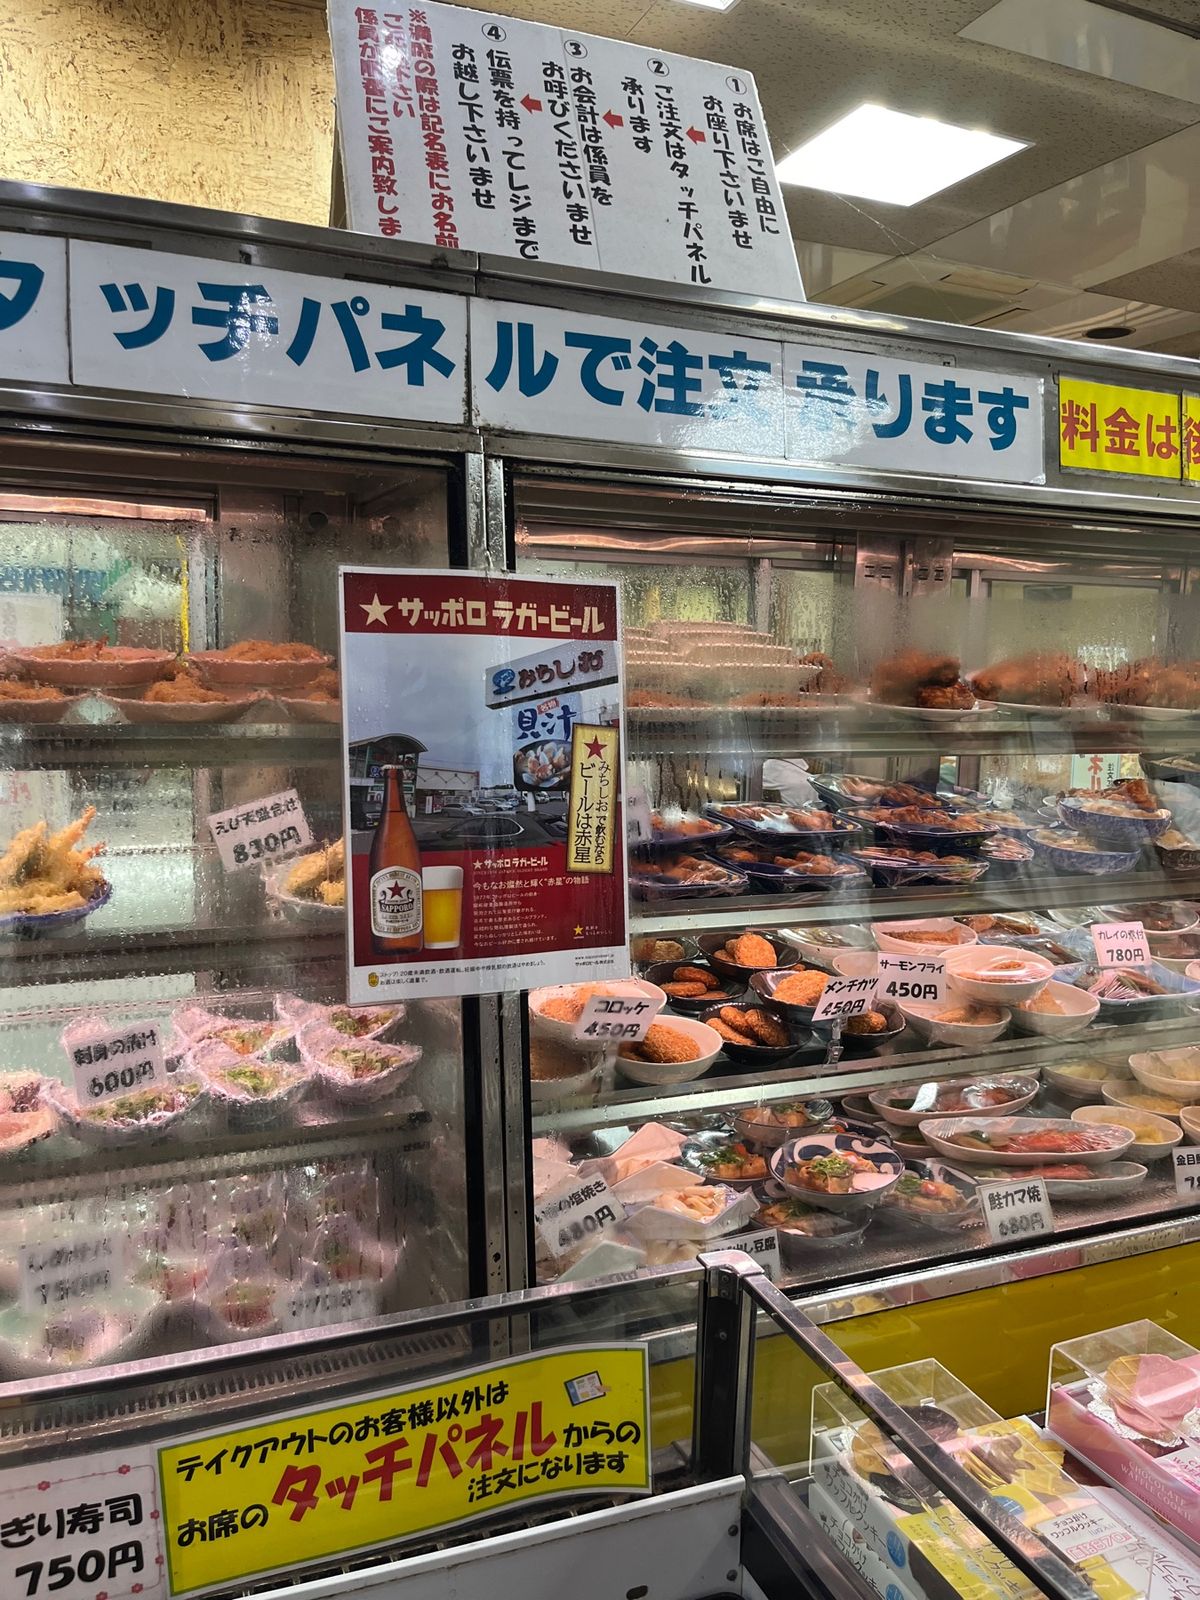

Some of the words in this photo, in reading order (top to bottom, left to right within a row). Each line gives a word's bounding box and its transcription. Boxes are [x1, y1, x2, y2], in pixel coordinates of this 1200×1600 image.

[452, 43, 495, 209] お越し下さいませ
[621, 76, 653, 153] 承ります
[542, 61, 591, 246] お呼びくださいませ
[703, 95, 752, 249] お座り下さいませ
[398, 597, 486, 627] サッポロ
[493, 600, 605, 633] ラガービール
[517, 705, 577, 742] 貝汁
[573, 762, 596, 864] ビールは赤星
[594, 761, 611, 865] みちしおで飲むなら
[233, 826, 301, 863] 830円
[381, 903, 413, 913] SAPPORO
[880, 959, 945, 974] サーモンフライ
[1106, 948, 1145, 962] 780円
[825, 978, 879, 994] メンチカツ
[886, 981, 938, 1000] 450円
[594, 1000, 649, 1015] コロッケ
[822, 999, 866, 1016] 450円
[584, 1021, 641, 1038] 450円
[88, 1060, 154, 1097] 600円
[988, 1185, 1041, 1211] 鮭カマ焼
[177, 1381, 509, 1481] テイクアウトのお客様以外は
[271, 1401, 557, 1522] タッチパネル
[563, 1420, 641, 1448] からの
[468, 1451, 629, 1503] 注文になります
[0, 1493, 143, 1548] ぎり寿司
[15, 1540, 145, 1597] 750円
